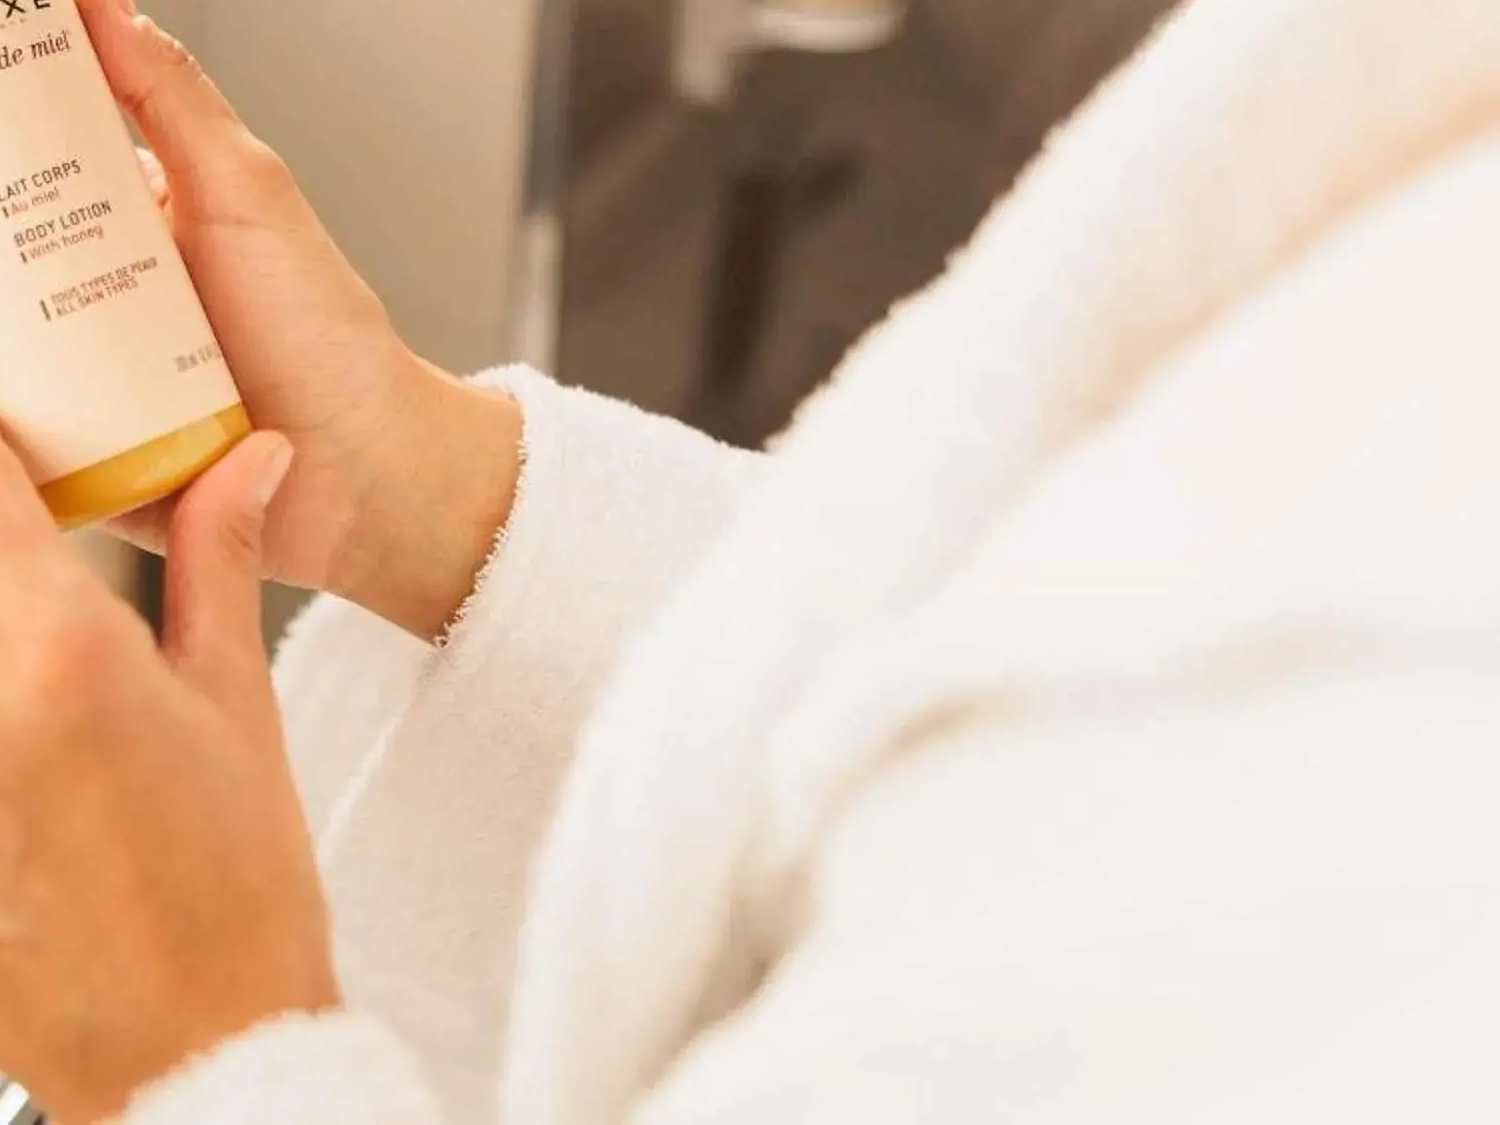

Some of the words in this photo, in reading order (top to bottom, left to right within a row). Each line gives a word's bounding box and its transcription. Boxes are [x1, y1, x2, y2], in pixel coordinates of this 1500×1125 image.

[32, 159, 82, 188] CORPS
[11, 201, 29, 216] Au
[31, 186, 60, 208] miel
[13, 220, 57, 248] BODY
[59, 199, 113, 229] LOTION
[29, 237, 60, 260] With
[61, 224, 105, 247] honey
[80, 271, 115, 293] TYPES
[104, 276, 139, 299] TYPES
